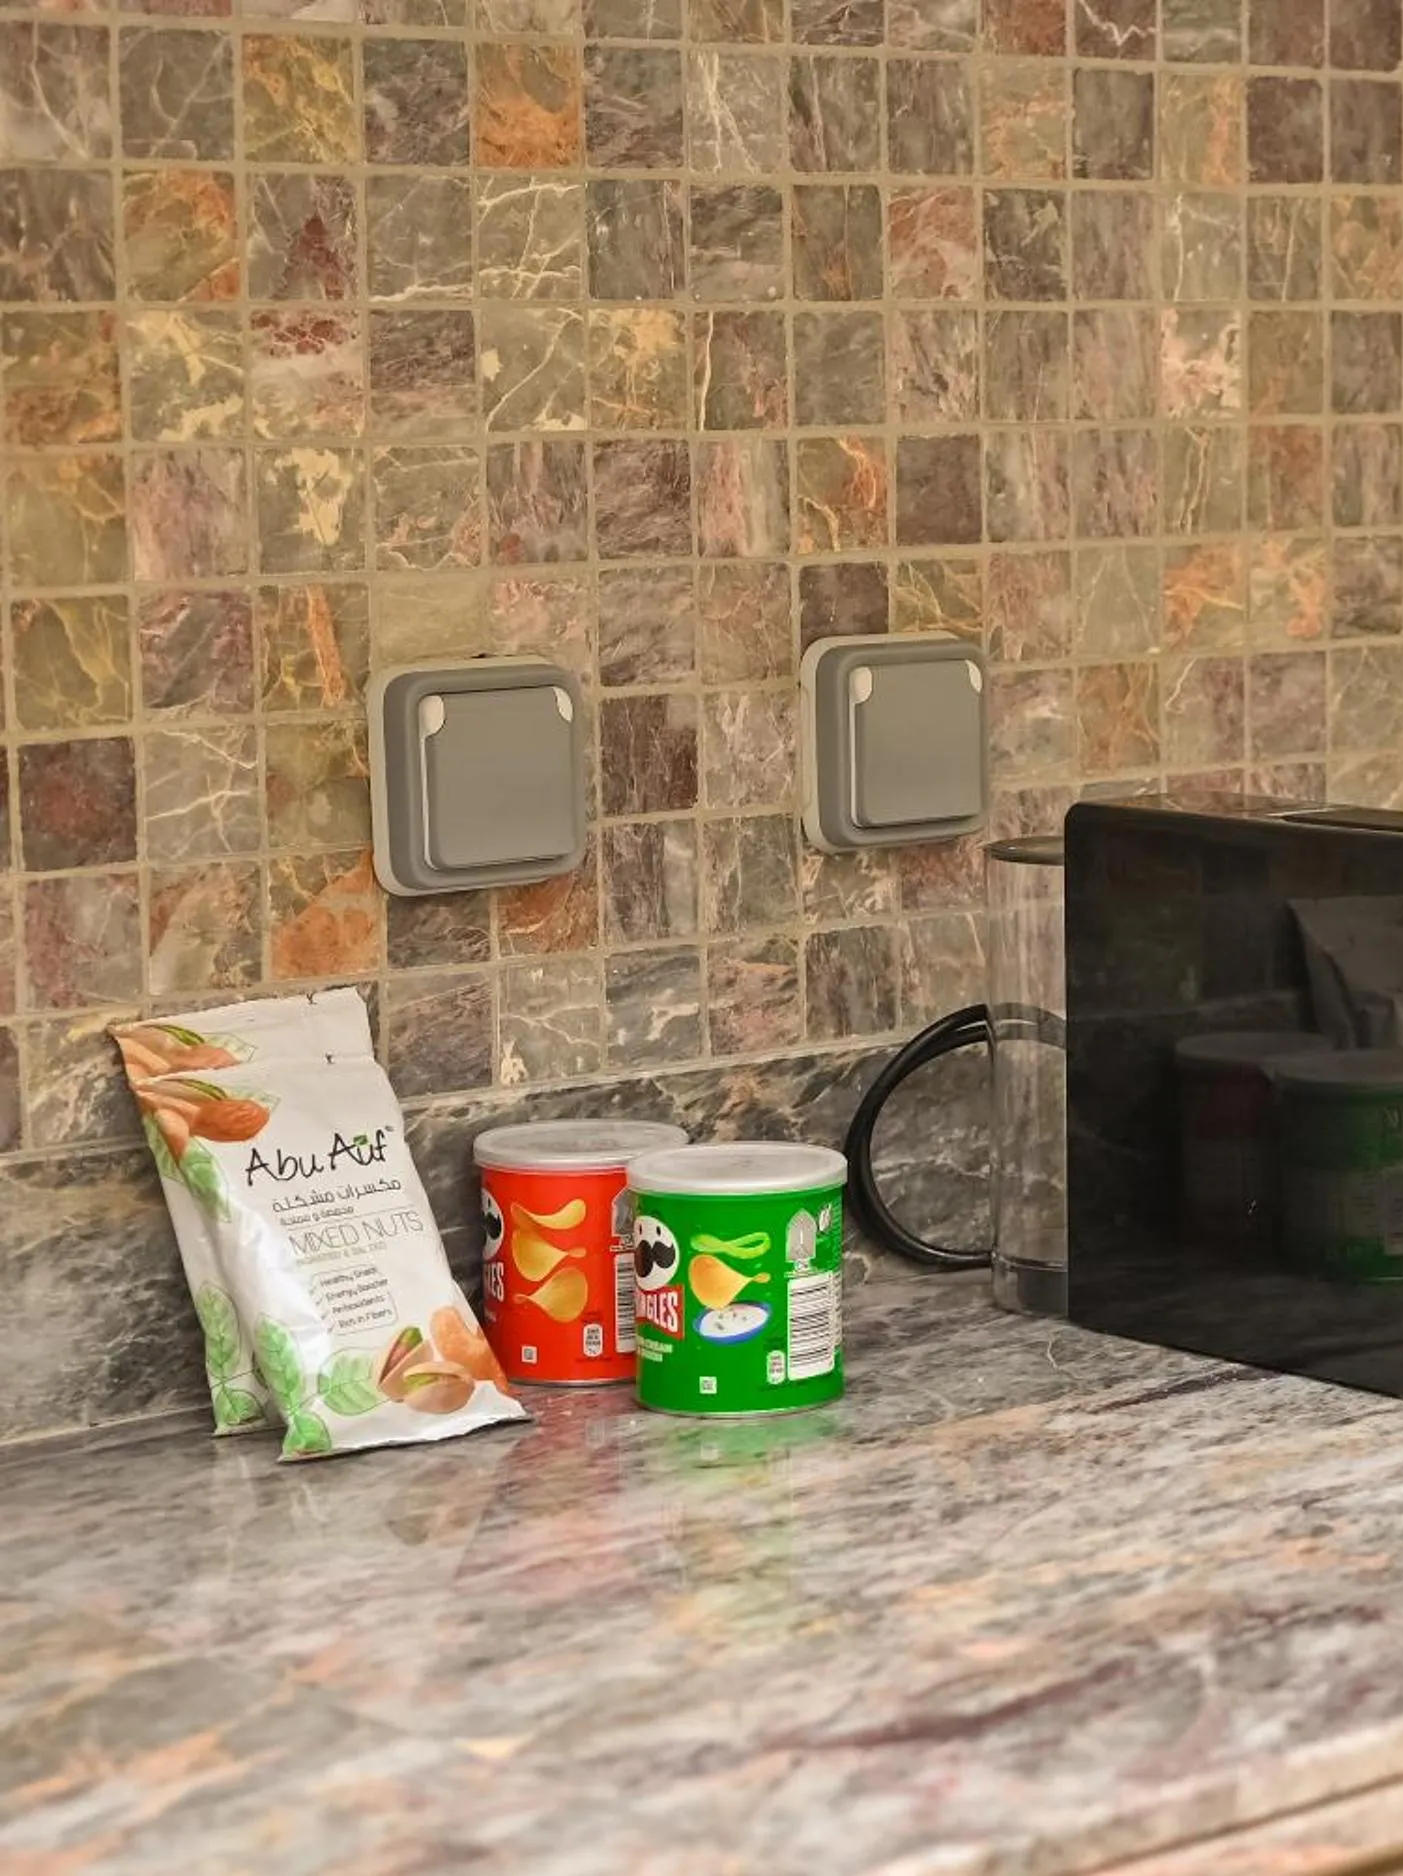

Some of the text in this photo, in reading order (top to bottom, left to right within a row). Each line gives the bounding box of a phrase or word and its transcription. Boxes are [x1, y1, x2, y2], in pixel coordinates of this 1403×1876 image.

[245, 1147, 325, 1187] Abu
[272, 1178, 402, 1213] مكسرات مشكلة
[288, 1210, 425, 1255] MIXED NUTS
